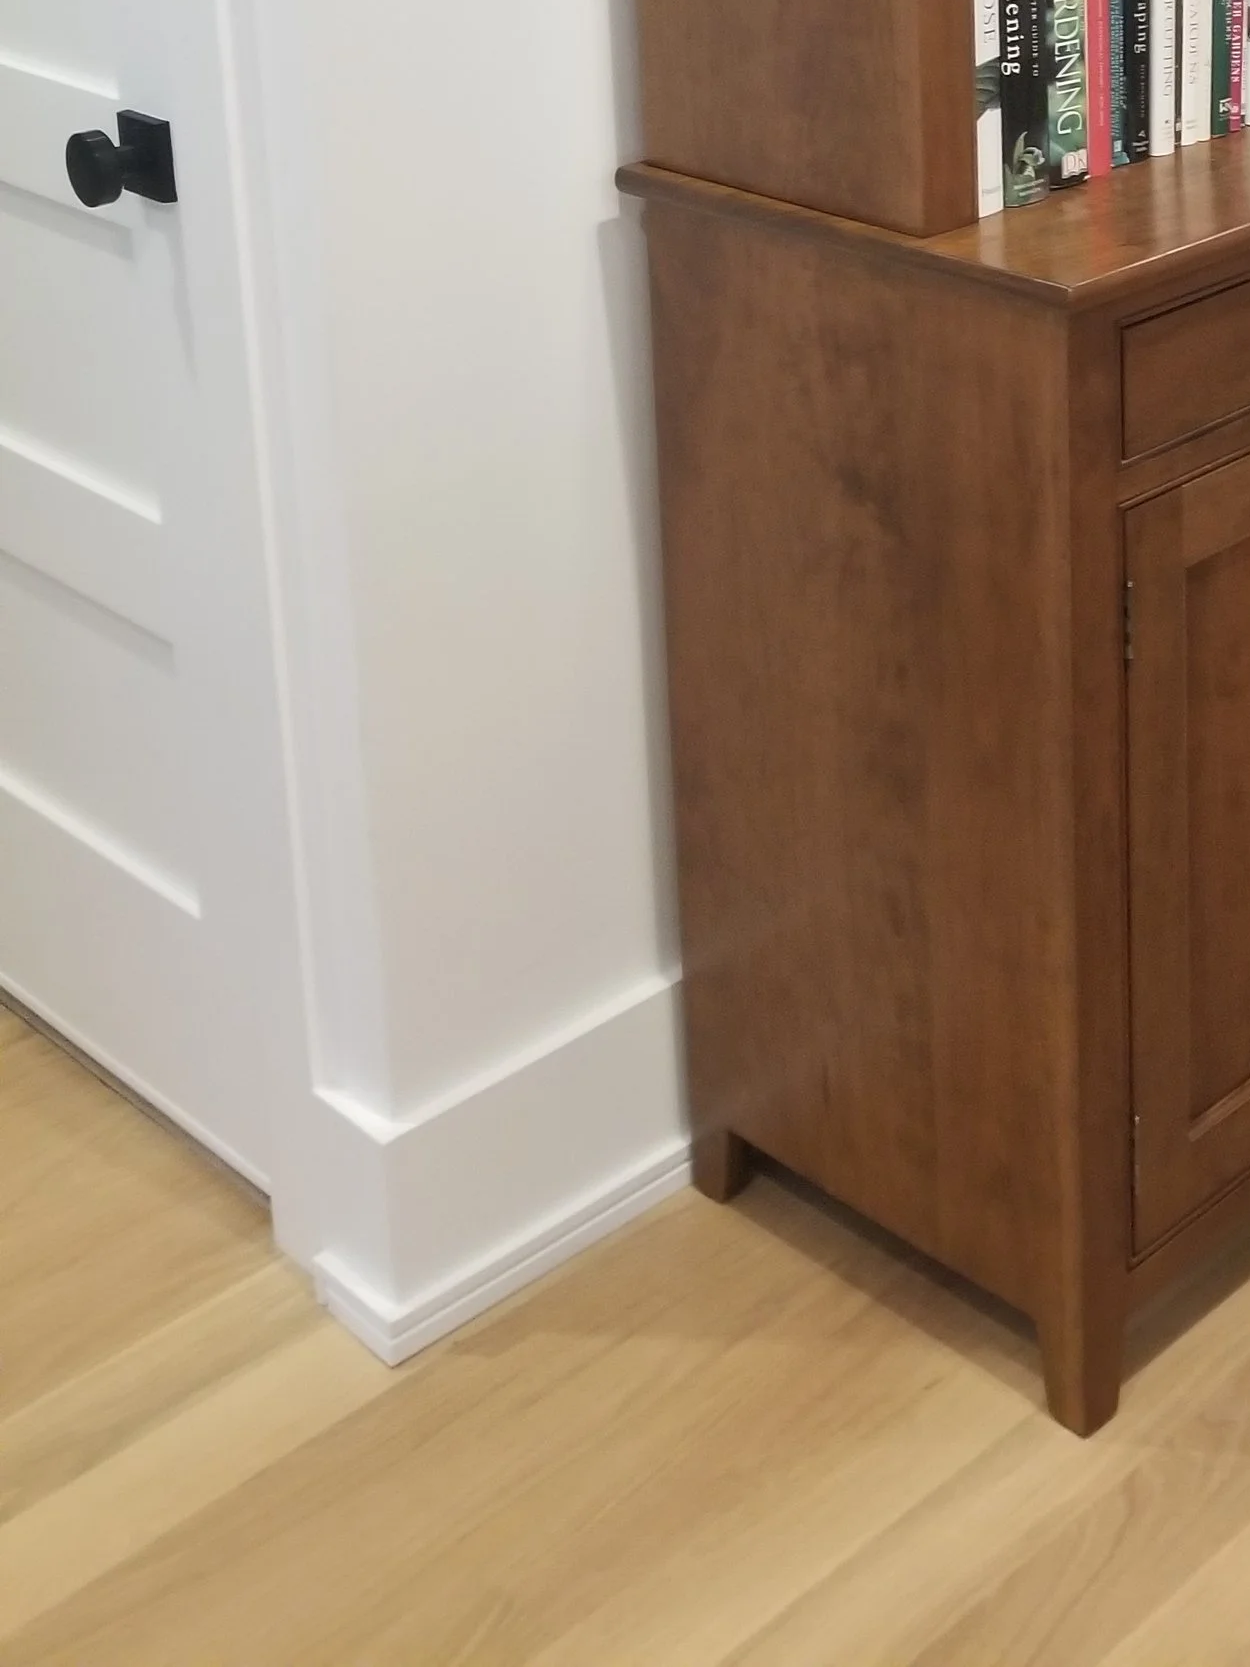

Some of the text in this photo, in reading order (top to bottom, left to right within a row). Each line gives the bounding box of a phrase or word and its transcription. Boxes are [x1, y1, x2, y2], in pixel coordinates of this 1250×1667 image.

[1031, 25, 1039, 58] GUIDE
[1163, 16, 1174, 98] CUTTING
[1229, 24, 1242, 84] GARDENS
[1032, 64, 1039, 77] TO
